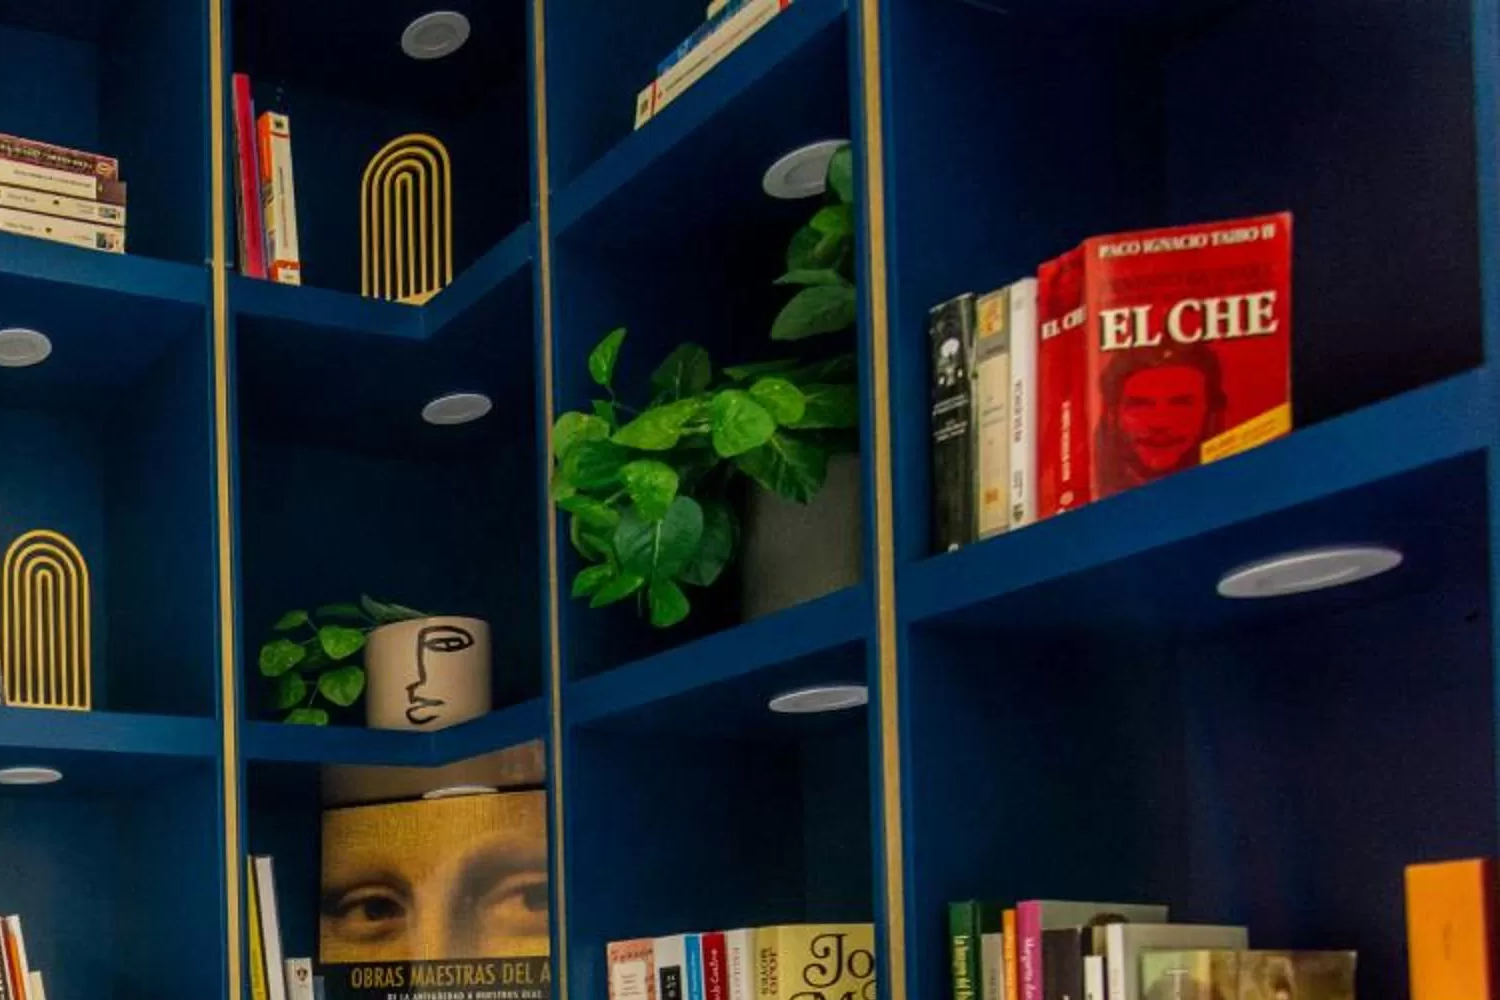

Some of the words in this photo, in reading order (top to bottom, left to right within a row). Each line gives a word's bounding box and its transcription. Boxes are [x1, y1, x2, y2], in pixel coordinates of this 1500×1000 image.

[1098, 239, 1141, 259] PACO
[1143, 233, 1208, 254] IGNACIO
[1098, 303, 1163, 351] EL
[1167, 290, 1280, 344] CHE
[351, 966, 405, 989] OBRAS
[409, 963, 496, 988] MAESTRAS
[502, 962, 534, 985] DEL
[803, 933, 874, 988] Jo
